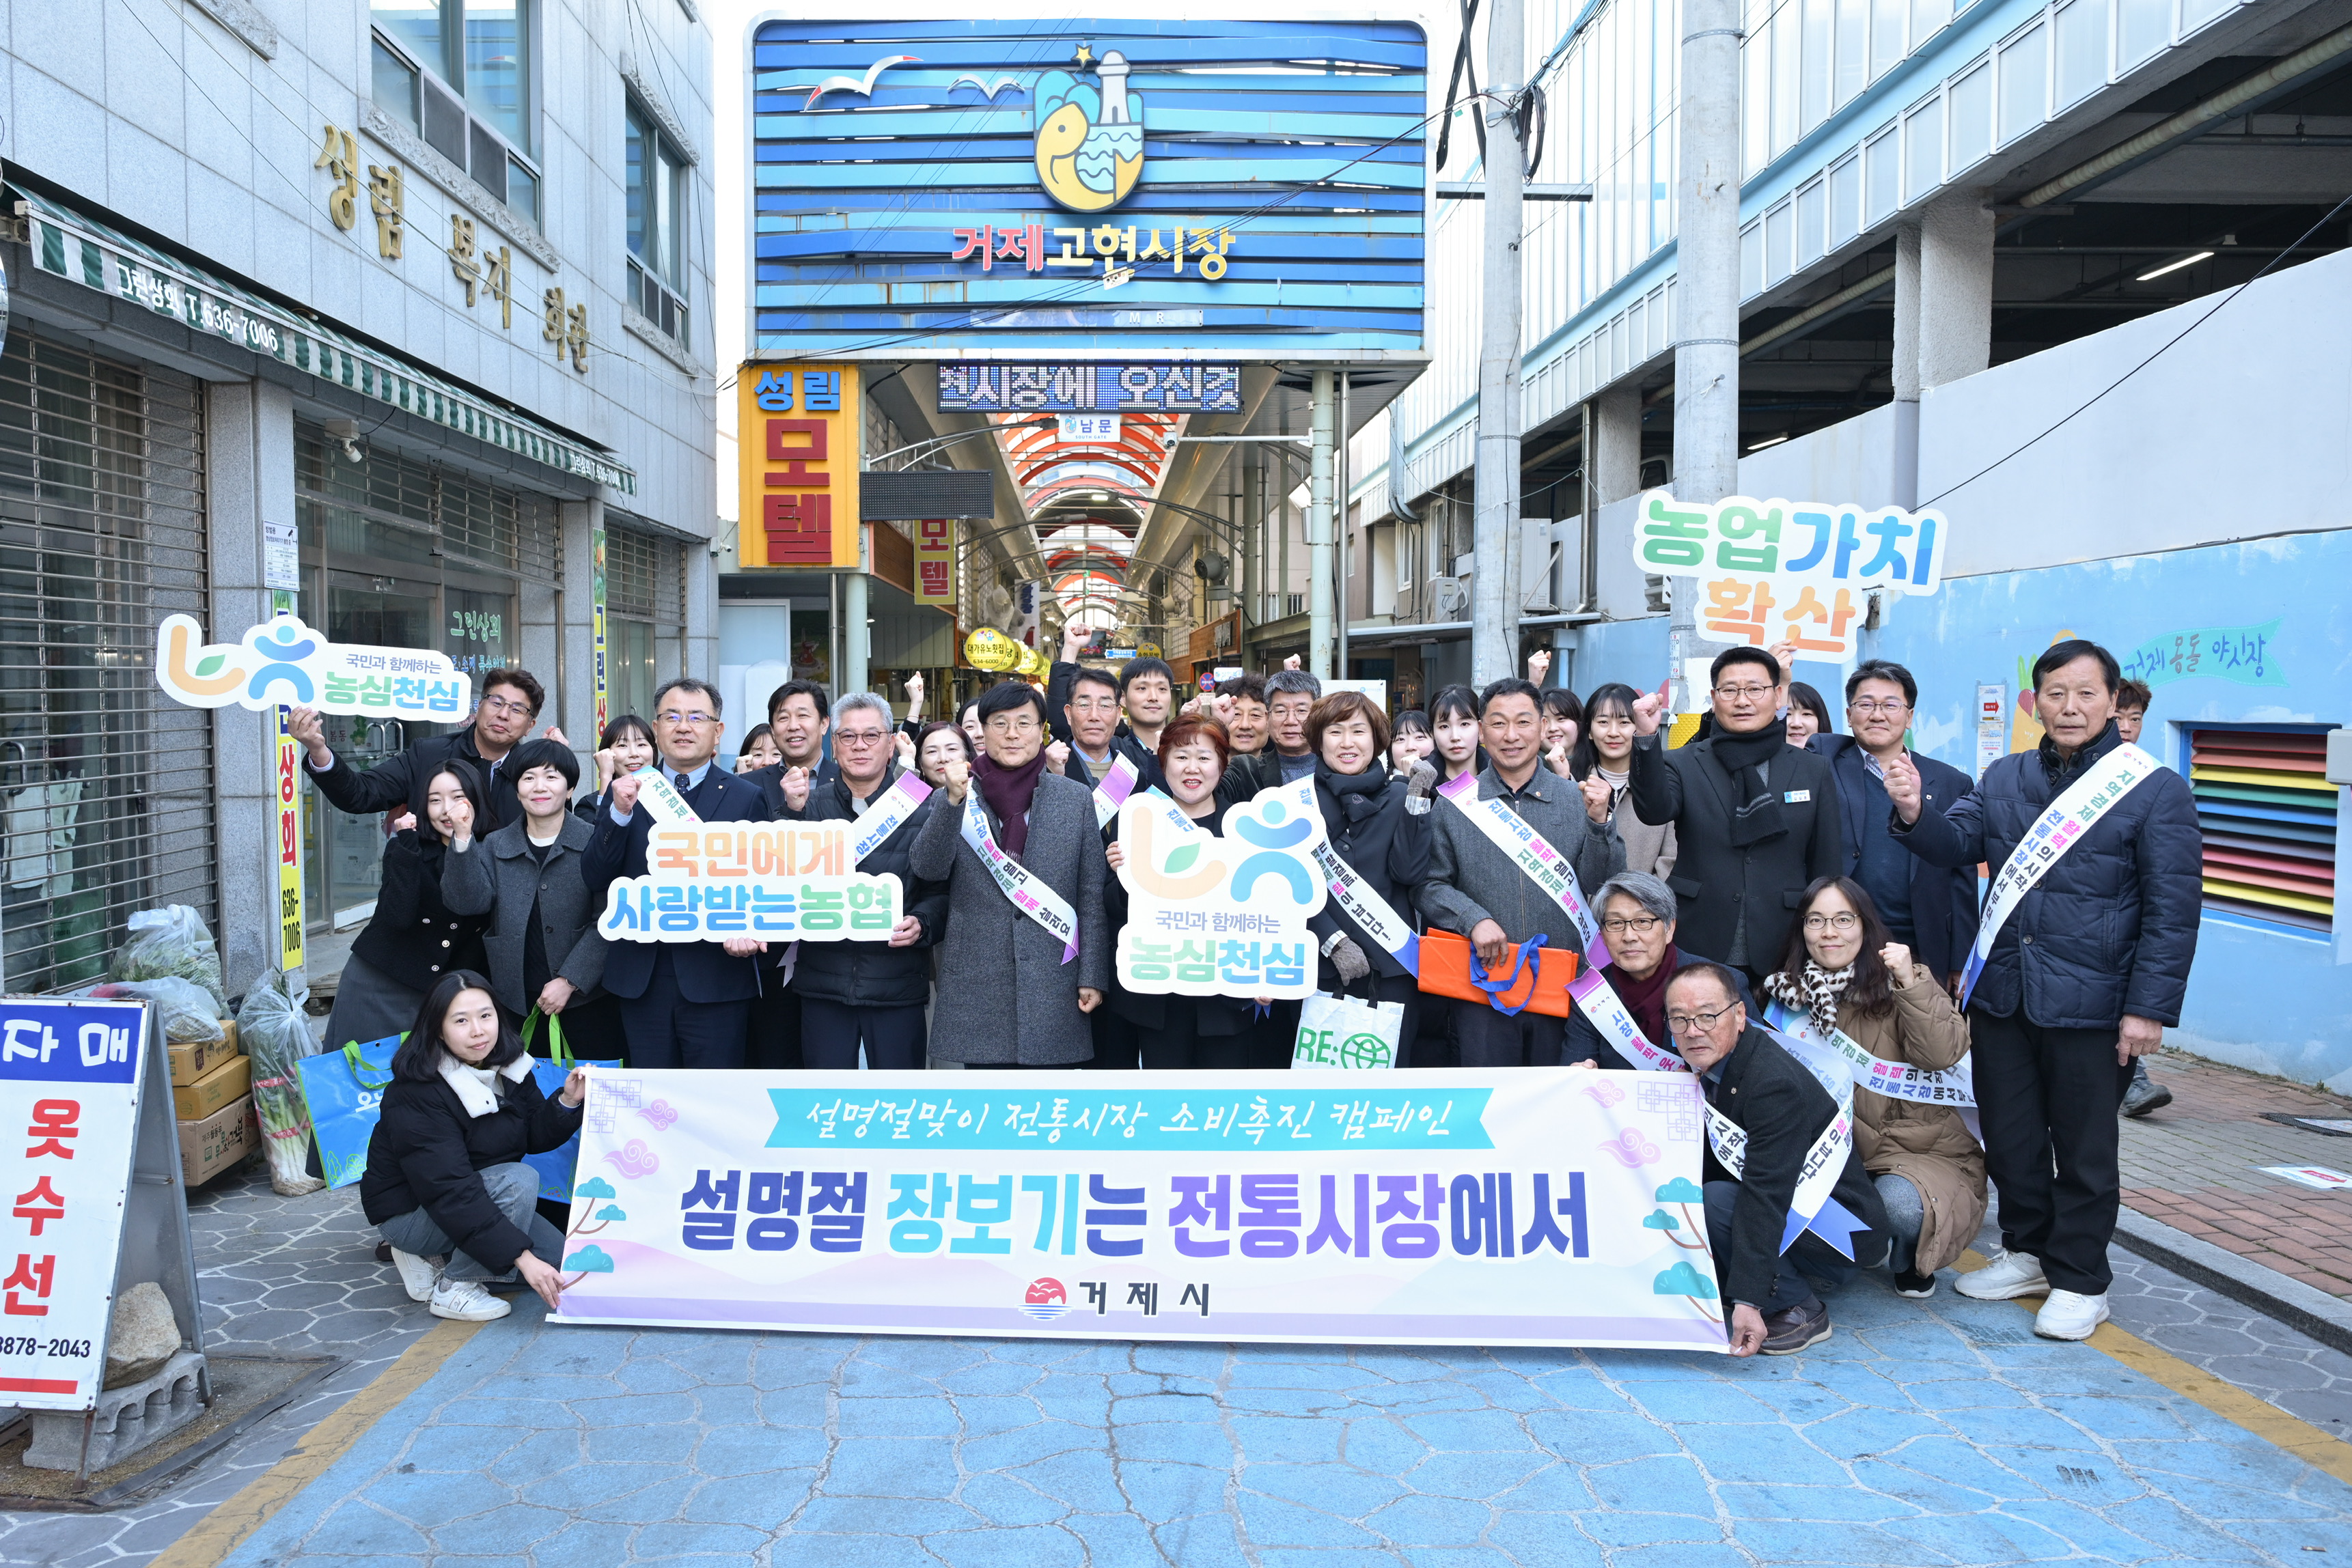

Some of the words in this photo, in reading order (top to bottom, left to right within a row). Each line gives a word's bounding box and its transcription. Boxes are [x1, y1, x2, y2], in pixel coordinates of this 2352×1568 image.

[314, 125, 404, 260] 성림
[447, 214, 511, 329] 복지
[542, 287, 588, 374] 회관
[952, 223, 1236, 280] 거제고현시장
[115, 262, 180, 314] 그린상회
[185, 292, 279, 352] T.636-7006
[753, 371, 840, 410] 성림
[764, 419, 832, 563] 모텔
[919, 519, 950, 596] 모텔
[1643, 499, 1937, 586] 농업가치
[451, 610, 501, 643] 그린상회
[1704, 577, 1857, 654] 확산
[346, 654, 386, 671] 국민과
[389, 656, 442, 675] 함께하는
[2124, 647, 2165, 680] 거제
[2170, 633, 2201, 674] 몽돌
[2212, 632, 2267, 677] 야시장
[324, 671, 460, 712] 농심천심
[652, 780, 689, 819] 지역경제
[2076, 770, 2136, 822] 지역경제
[656, 830, 844, 878] 국민에게
[855, 814, 899, 856] 전통시장
[967, 798, 987, 839] 전통시장
[983, 838, 1004, 863] 활짝
[1003, 861, 1029, 886] 열고
[1489, 800, 1532, 842] 전통시장
[1530, 839, 1556, 863] 활짝
[1554, 860, 1575, 886] 열고
[2036, 820, 2082, 863] 활력의
[977, 845, 1015, 893] 지역경제
[1012, 889, 1040, 912] 함께
[1039, 907, 1071, 937] 살려요
[1517, 848, 1565, 895] 지역경제
[1561, 891, 1579, 915] 함께
[607, 883, 892, 932] 사랑받는농협
[1156, 912, 1207, 932] 국민과
[1212, 912, 1281, 934] 함께하는
[1331, 882, 1355, 906] 힘이
[1351, 904, 1392, 942] 납니다!
[1129, 936, 1306, 987] 농심천심
[1611, 1009, 1633, 1038] 시장
[1825, 1034, 1870, 1069] 역경제
[1872, 1061, 1919, 1082] 활력의
[807, 1097, 989, 1139] 설명절맞이
[1004, 1097, 1148, 1145] 전통시장
[1160, 1095, 1316, 1145] 소비촉진
[1329, 1098, 1453, 1141] 캠페인
[680, 1168, 868, 1253] 설명절
[886, 1171, 1147, 1257] 장보기는
[1168, 1171, 1590, 1259] 전통시장에서
[1079, 1281, 1209, 1317] 거제시
